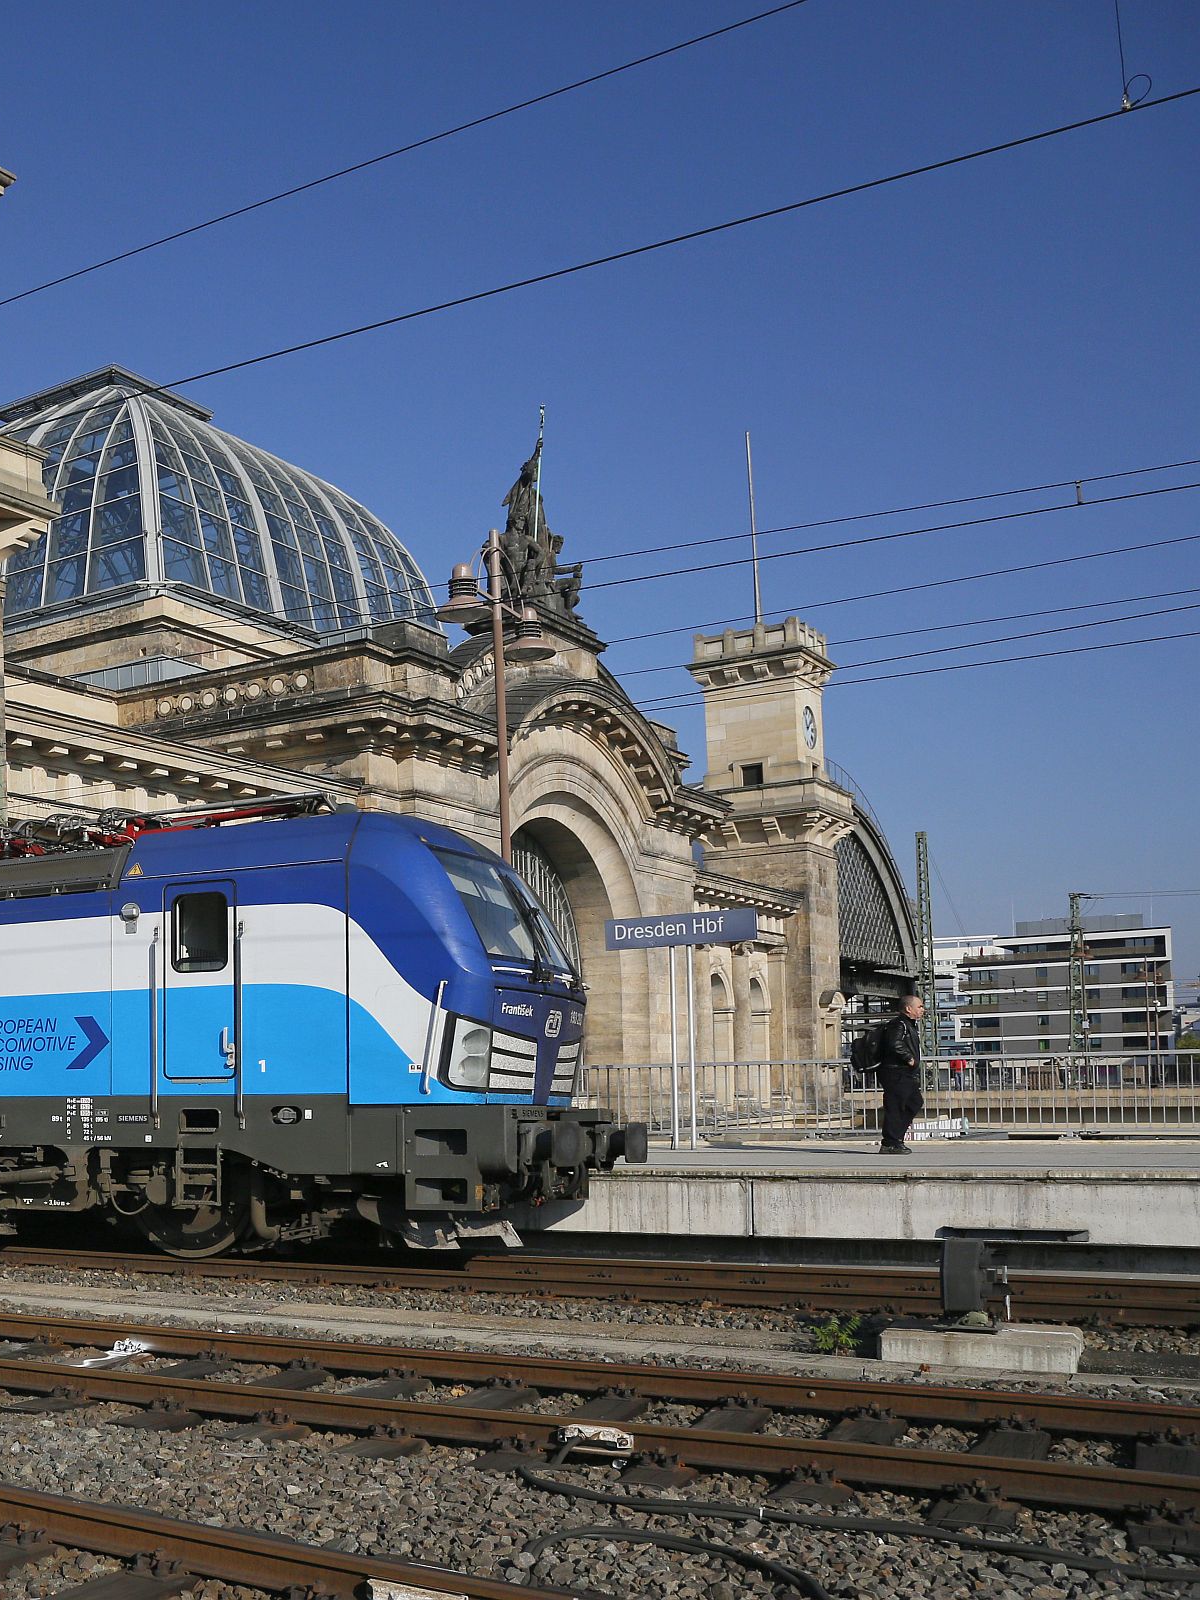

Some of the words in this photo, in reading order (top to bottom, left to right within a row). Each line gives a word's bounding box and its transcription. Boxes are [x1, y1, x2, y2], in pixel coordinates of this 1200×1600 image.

[614, 921, 686, 941] Dresden
[693, 916, 724, 935] Hbf
[501, 1002, 534, 1017] František
[258, 1059, 266, 1073] 1
